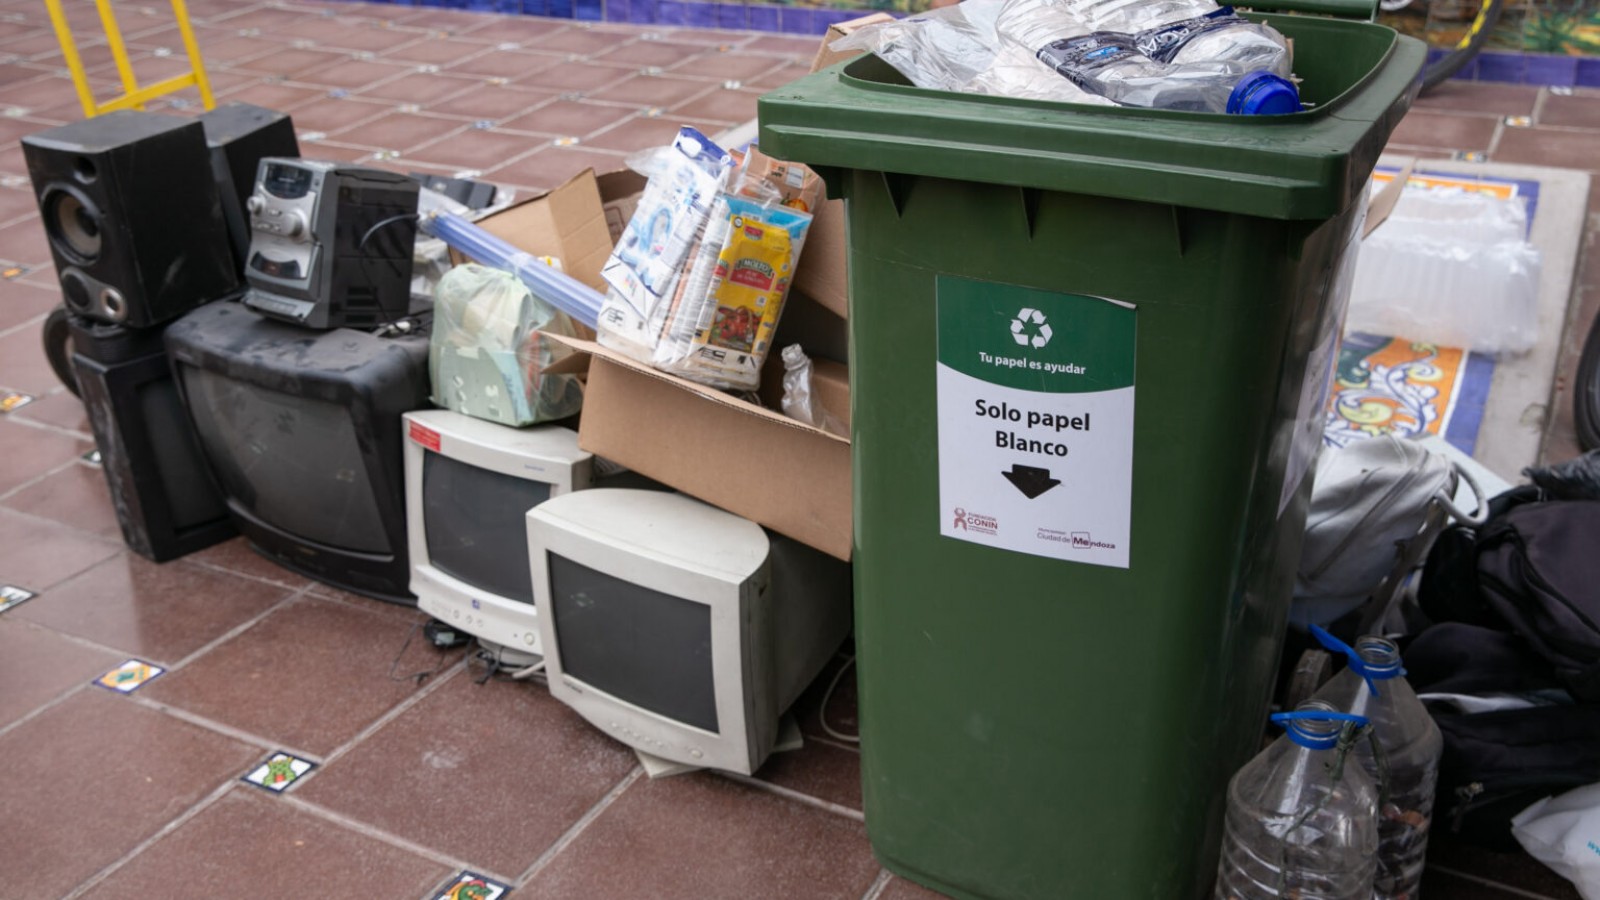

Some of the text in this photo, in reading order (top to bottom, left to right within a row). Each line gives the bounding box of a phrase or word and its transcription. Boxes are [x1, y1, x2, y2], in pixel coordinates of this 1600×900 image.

[979, 352, 1086, 375] Tu papel es ayudar
[975, 399, 1090, 433] Solo papel
[995, 430, 1068, 457] Blanco
[967, 517, 998, 529] CONIN
[1037, 532, 1061, 542] Ciudad
[1073, 537, 1116, 549] Mendoza
